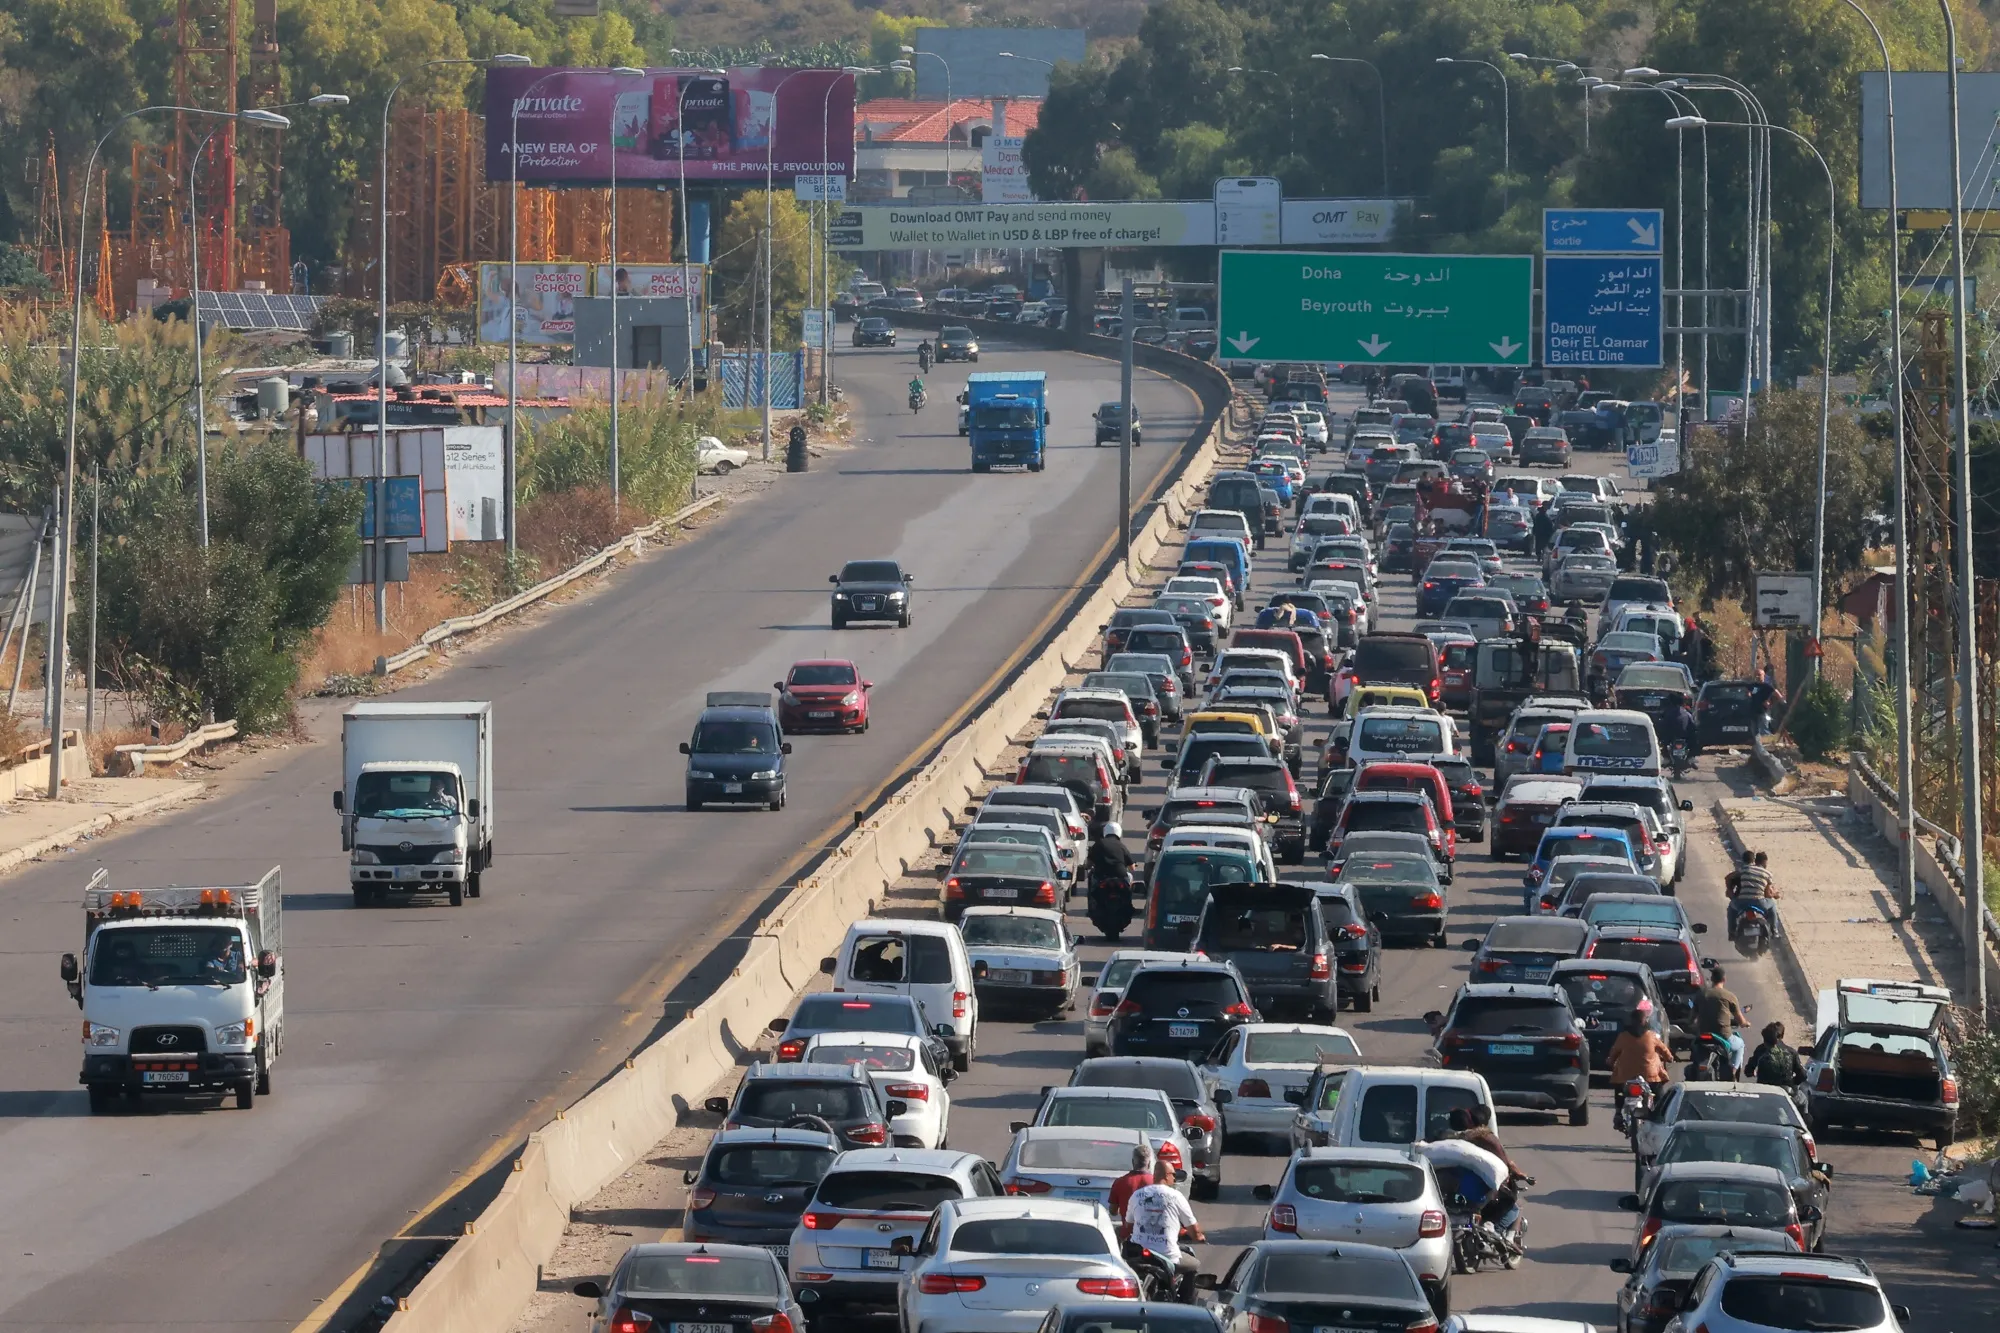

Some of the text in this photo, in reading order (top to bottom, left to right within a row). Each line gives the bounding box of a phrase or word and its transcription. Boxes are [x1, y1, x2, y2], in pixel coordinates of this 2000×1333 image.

[512, 95, 581, 118] private
[501, 143, 598, 153] A NEW ERA OF
[520, 154, 580, 167] Protection
[890, 210, 1111, 224] Download OMT Pay and send money
[1312, 210, 1380, 223] OMT Pay
[1551, 217, 1587, 231] مخرج
[890, 227, 1160, 242] Wallet to Wallet in USD & LBP free of charge!
[1553, 236, 1582, 245] sortie
[535, 273, 582, 282] PACK TO
[651, 275, 680, 284] PACK
[1302, 266, 1342, 280] Doha
[1384, 267, 1450, 286] الدوحة
[1599, 267, 1652, 282] الدامور
[534, 284, 582, 293] SCHOOL
[651, 285, 698, 294] SCHOL
[1594, 284, 1651, 298] دير القمر
[1301, 299, 1372, 314] Beyrouth
[1384, 301, 1450, 317] بيروت
[1588, 301, 1650, 316] بيت الدين
[1551, 322, 1596, 334] Damour
[1551, 336, 1649, 349] Deir EL Qamar
[1551, 350, 1624, 361] Beit EL Dine
[461, 452, 486, 461] Series
[158, 1073, 184, 1081] 760567
[678, 1325, 684, 1333] S
